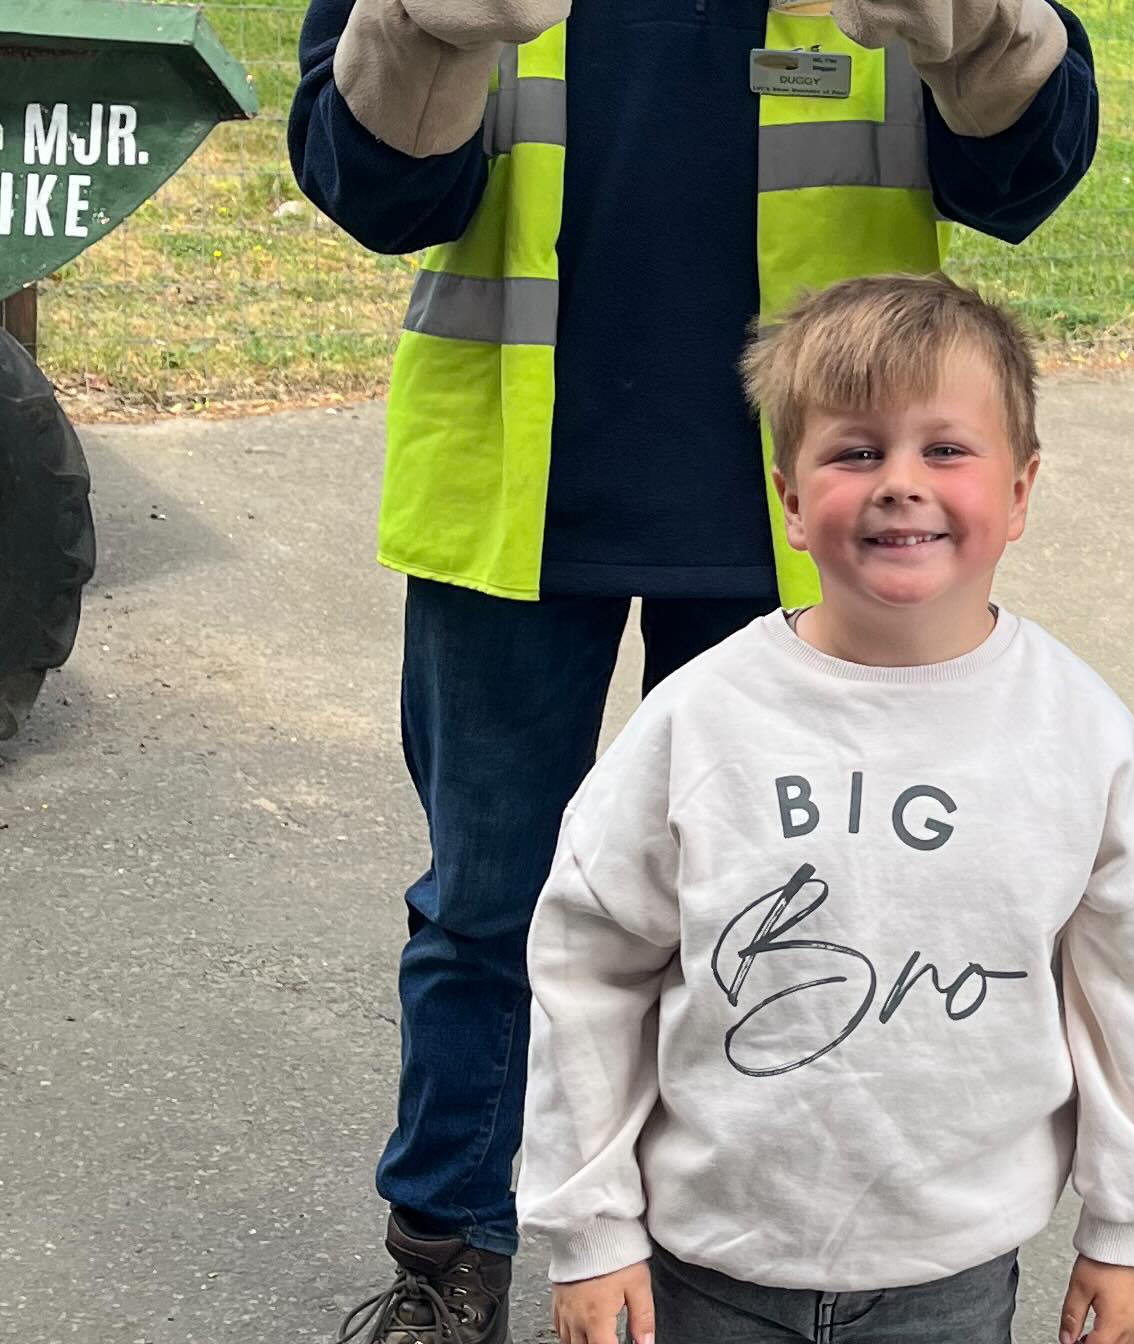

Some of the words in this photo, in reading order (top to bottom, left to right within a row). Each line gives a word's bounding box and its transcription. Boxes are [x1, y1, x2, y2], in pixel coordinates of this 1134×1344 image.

[24, 103, 149, 166] MJR.
[775, 771, 957, 851] BIG
[711, 863, 1028, 1077] Bro
